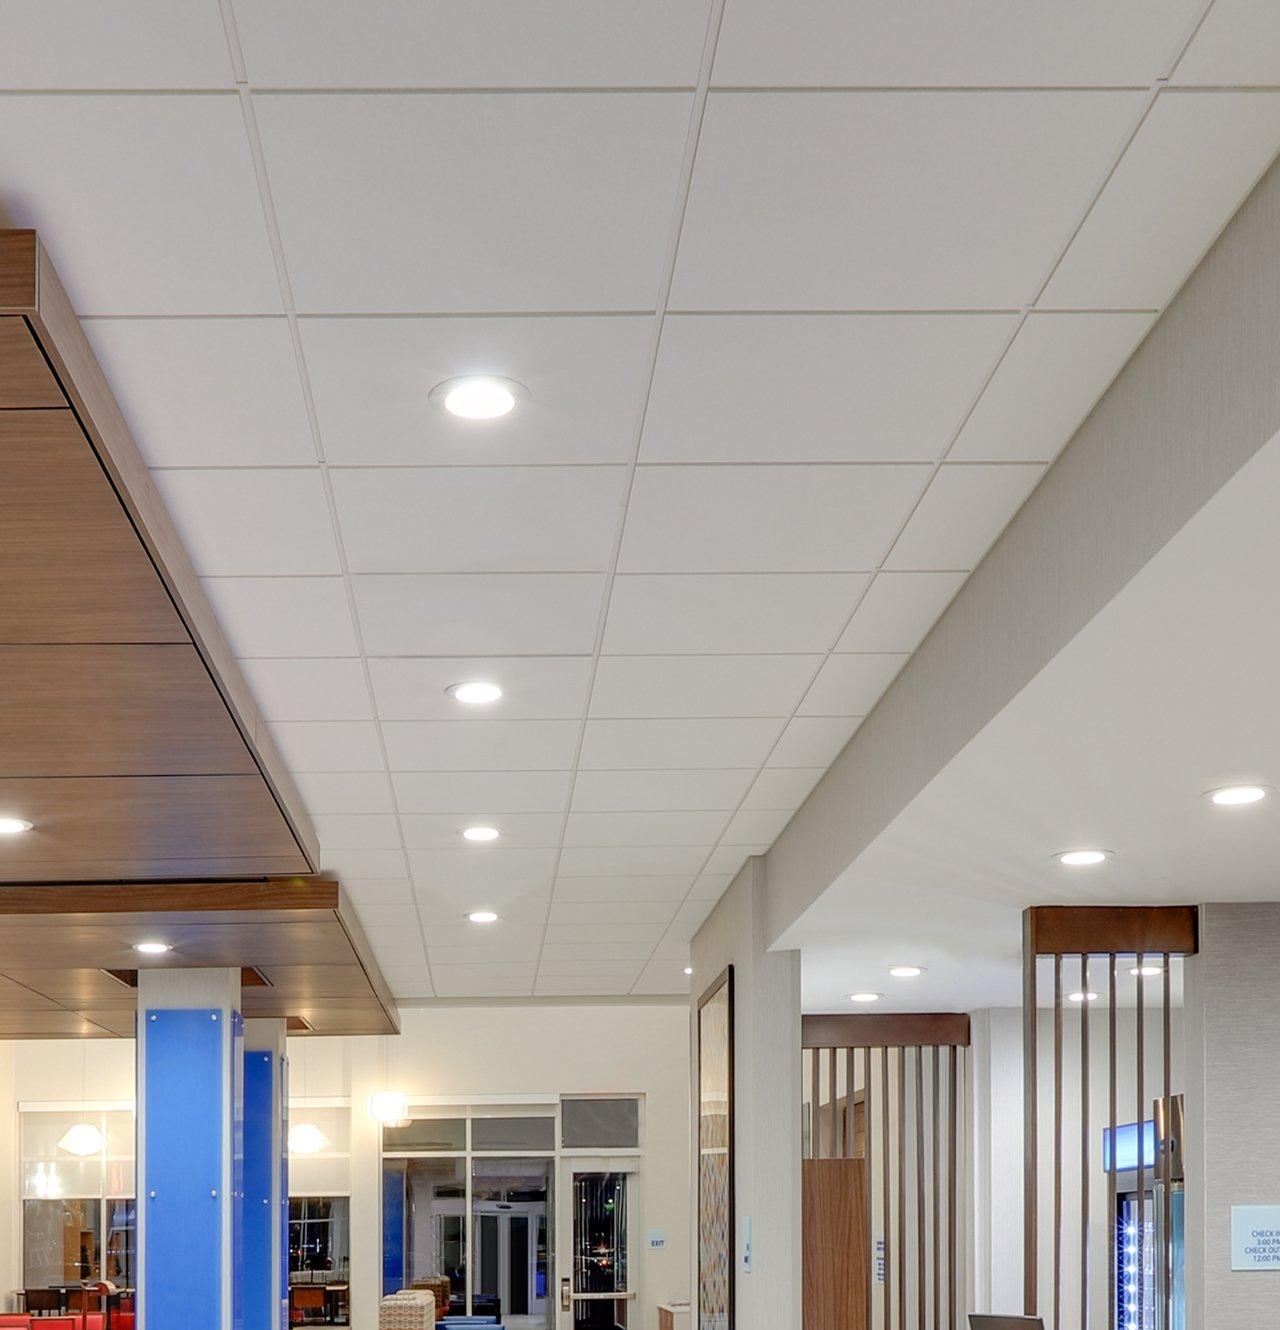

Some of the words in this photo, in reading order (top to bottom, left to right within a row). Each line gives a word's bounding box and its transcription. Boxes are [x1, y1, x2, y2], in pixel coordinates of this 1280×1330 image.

[1251, 1230, 1274, 1238] CHECK
[1257, 1238, 1271, 1246] 3:00
[1245, 1246, 1267, 1254] CHECK
